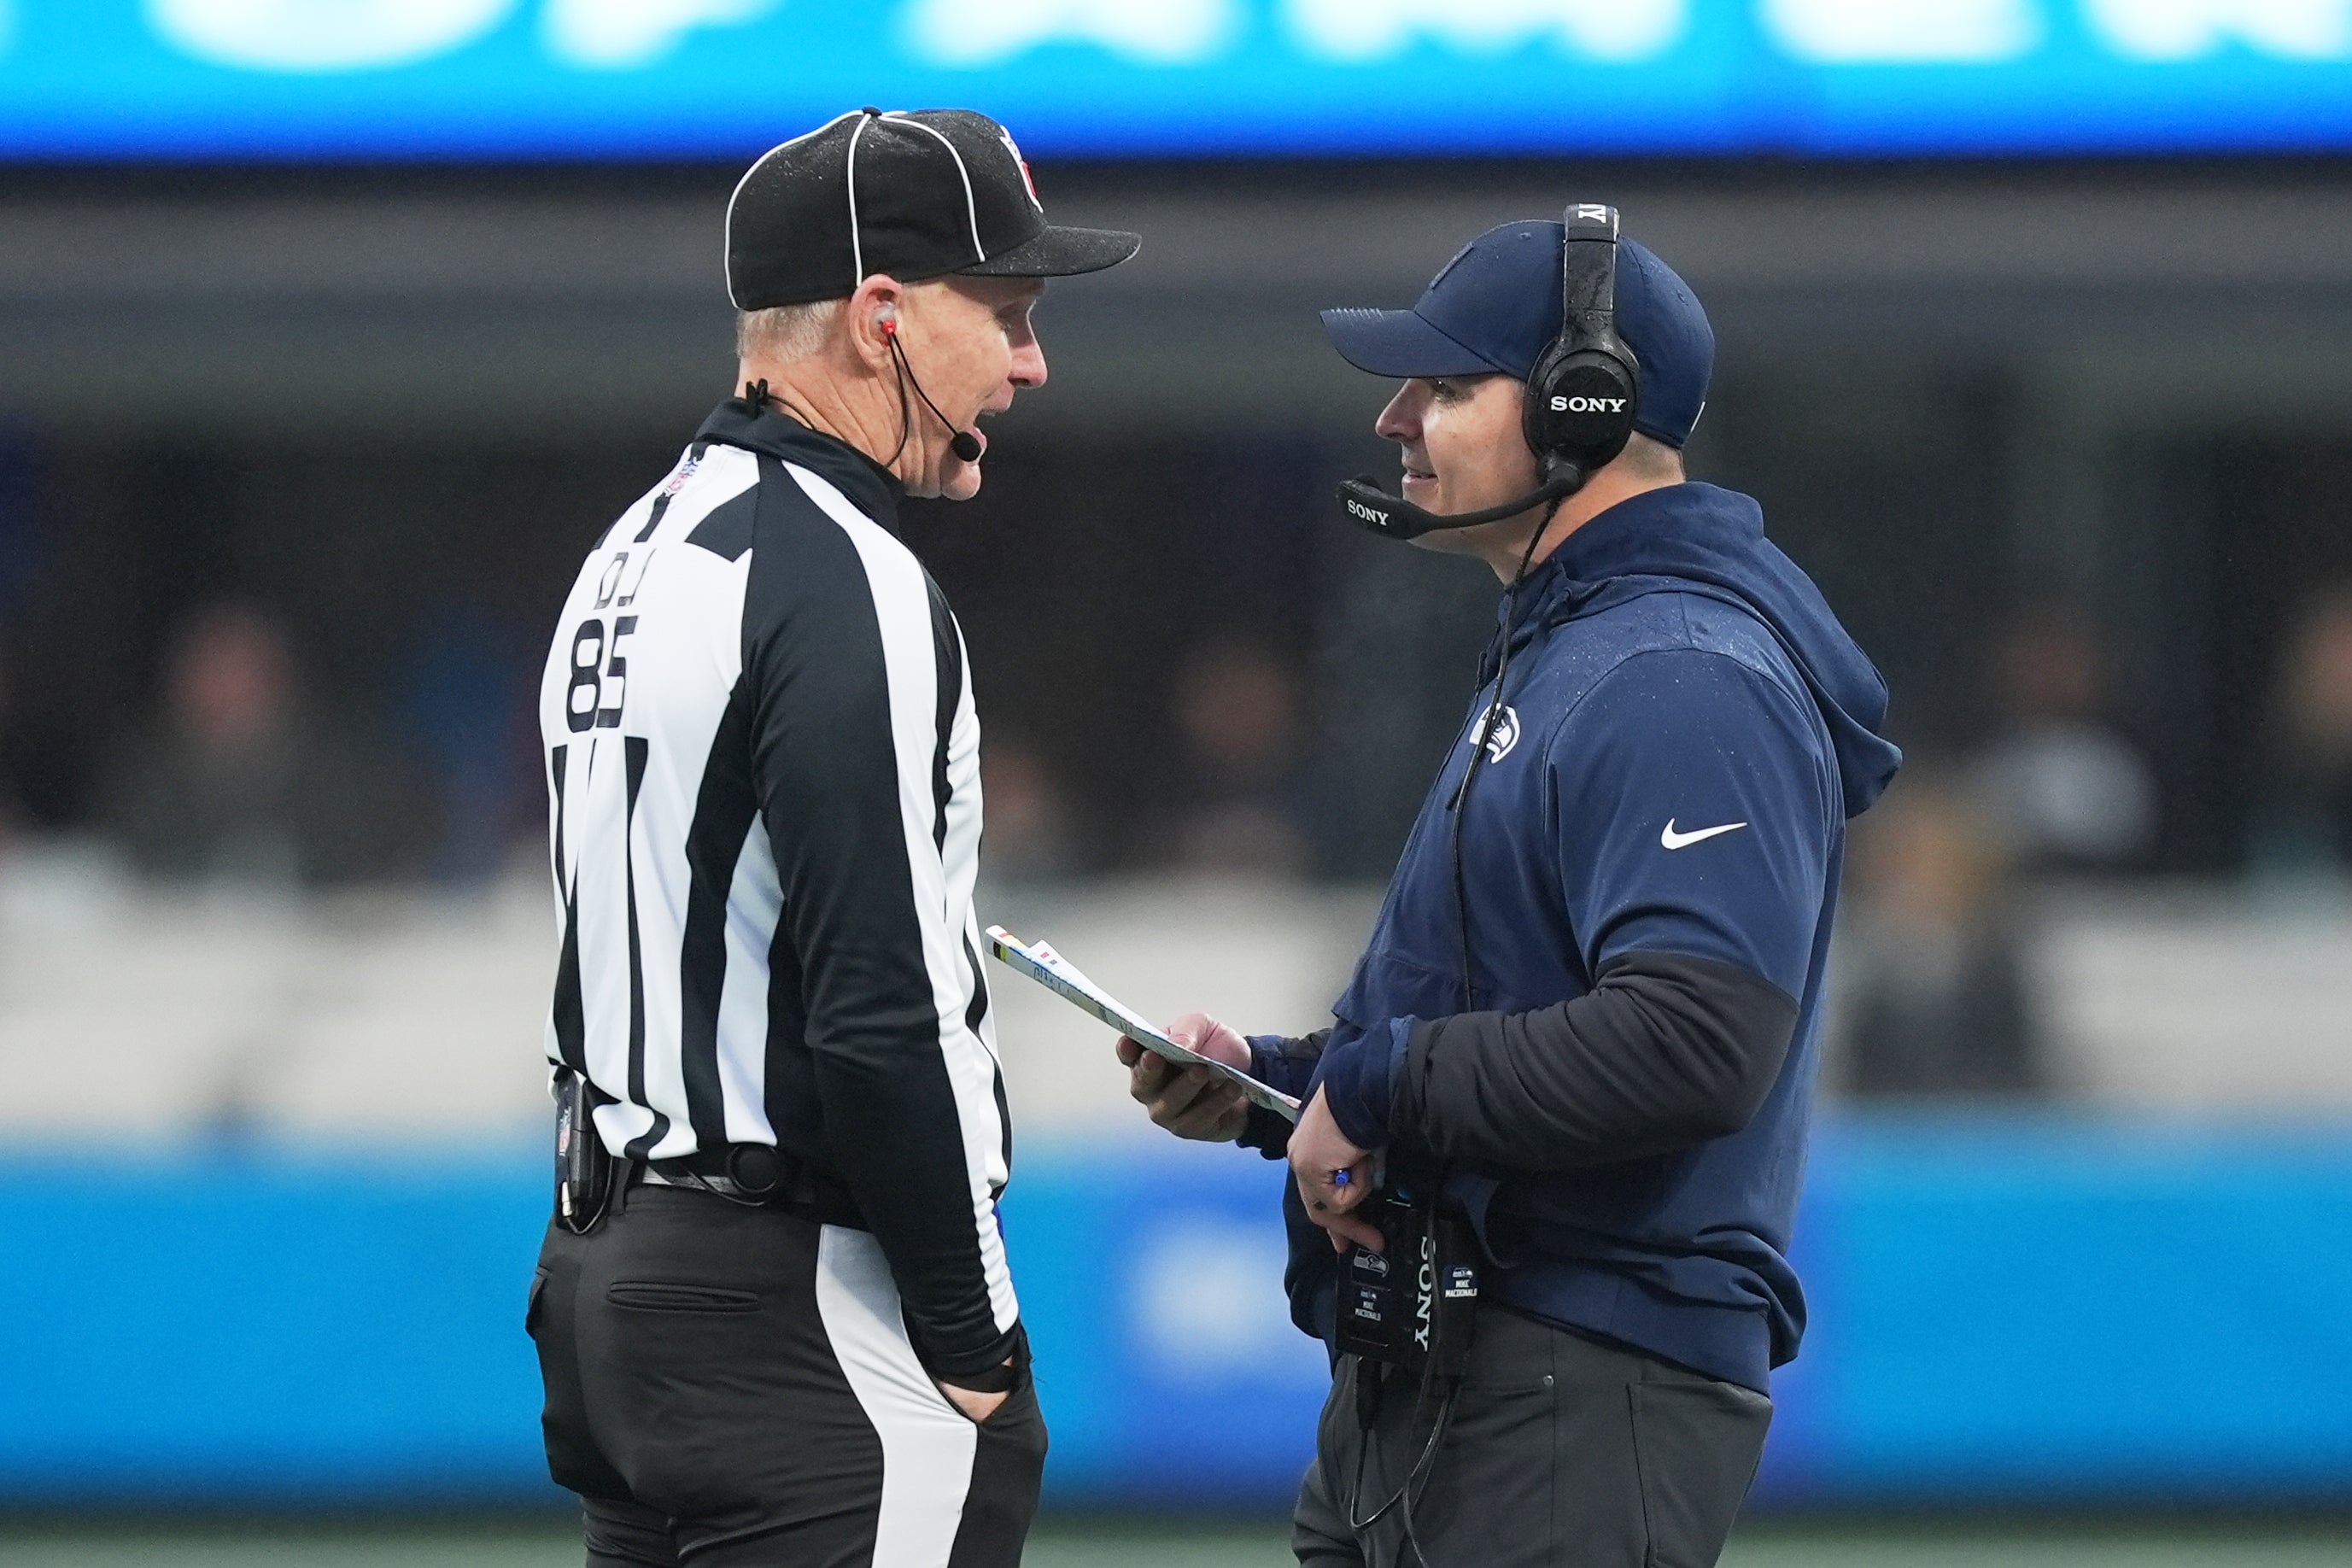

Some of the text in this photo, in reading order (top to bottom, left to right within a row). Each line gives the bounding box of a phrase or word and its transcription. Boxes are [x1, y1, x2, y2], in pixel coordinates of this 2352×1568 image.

[1550, 395, 1627, 412] SONY
[1347, 499, 1389, 526] SONY
[566, 615, 639, 733] 85
